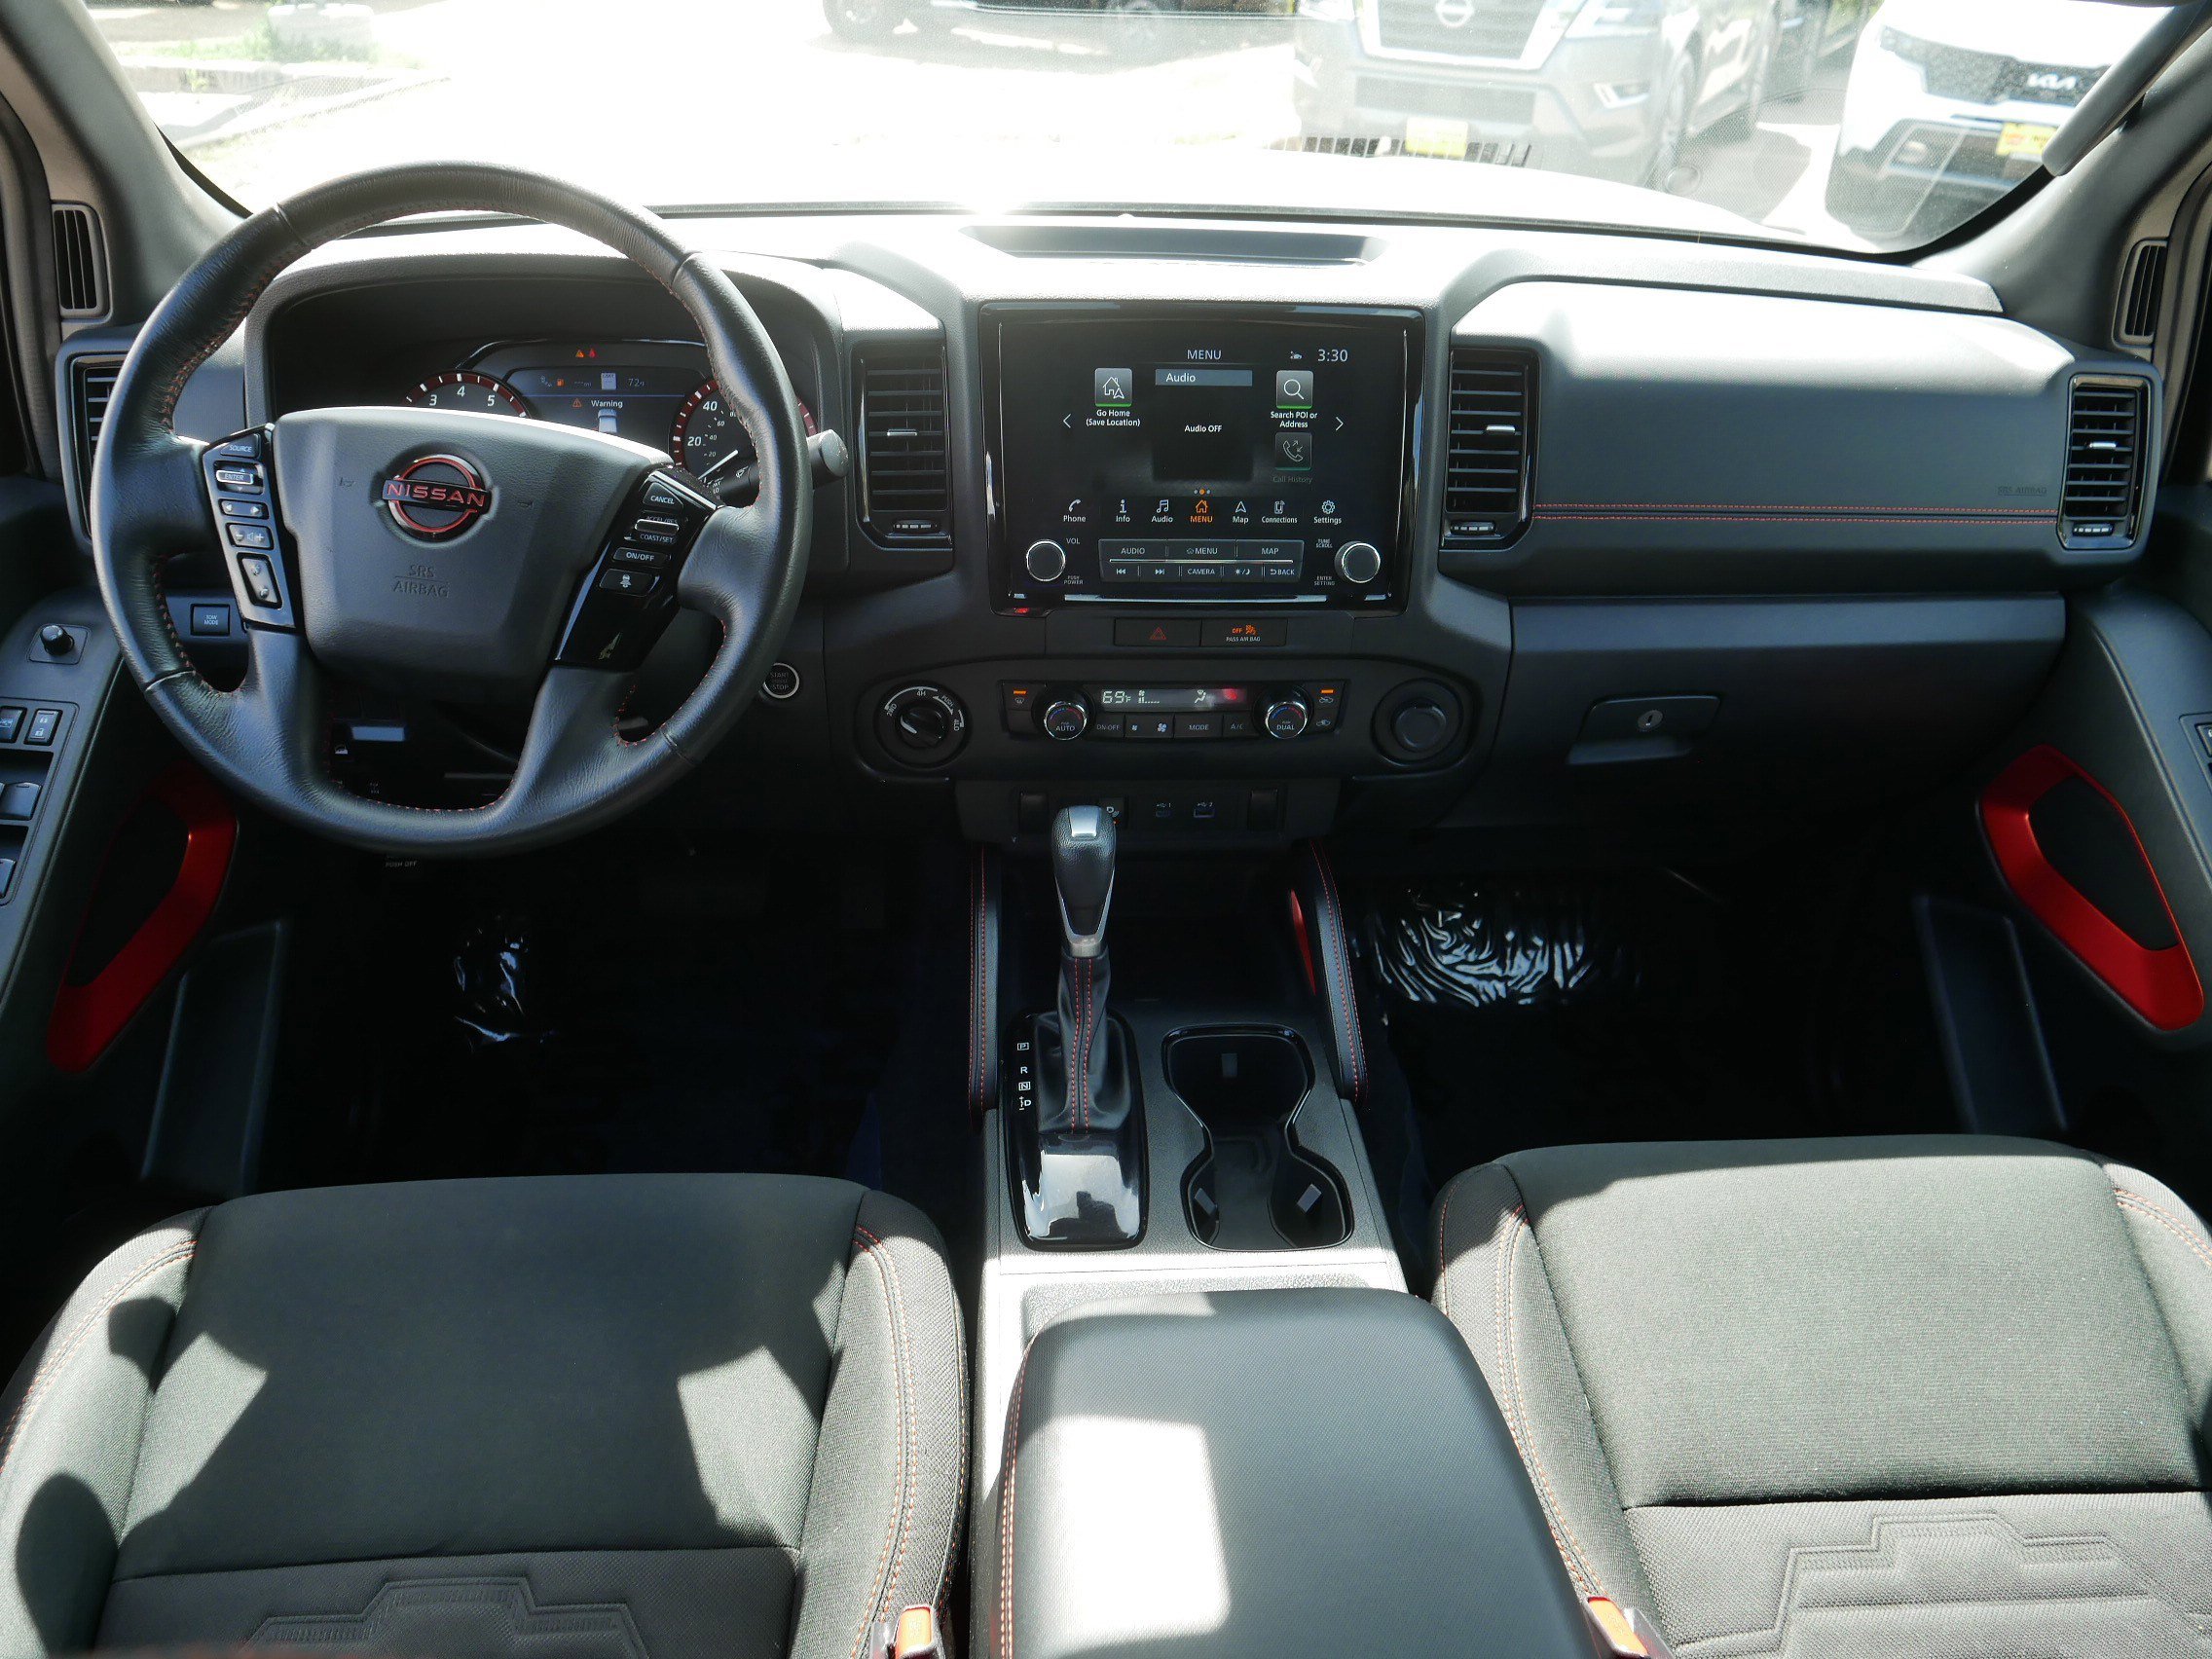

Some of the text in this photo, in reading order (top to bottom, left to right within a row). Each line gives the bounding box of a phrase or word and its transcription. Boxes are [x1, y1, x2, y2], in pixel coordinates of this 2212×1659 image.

[1187, 349, 1222, 360] MENU
[1317, 349, 1348, 362] 3:30
[1165, 373, 1196, 383] Audio
[456, 385, 466, 397] 4
[429, 395, 437, 406] 3
[487, 395, 495, 406] 5
[590, 400, 623, 408] Warning
[702, 401, 718, 411] 40
[687, 436, 701, 446] 20
[1288, 476, 1313, 484] History
[387, 484, 485, 507] NISSAN
[650, 495, 675, 505] CANCEL
[1232, 516, 1249, 525] Map
[1314, 516, 1342, 525] Settings
[640, 534, 673, 543] COAST/SET
[626, 552, 655, 561] ON/OFF
[409, 564, 435, 577] SRS
[393, 581, 450, 598] AIRBAG
[886, 703, 897, 717] 2WD
